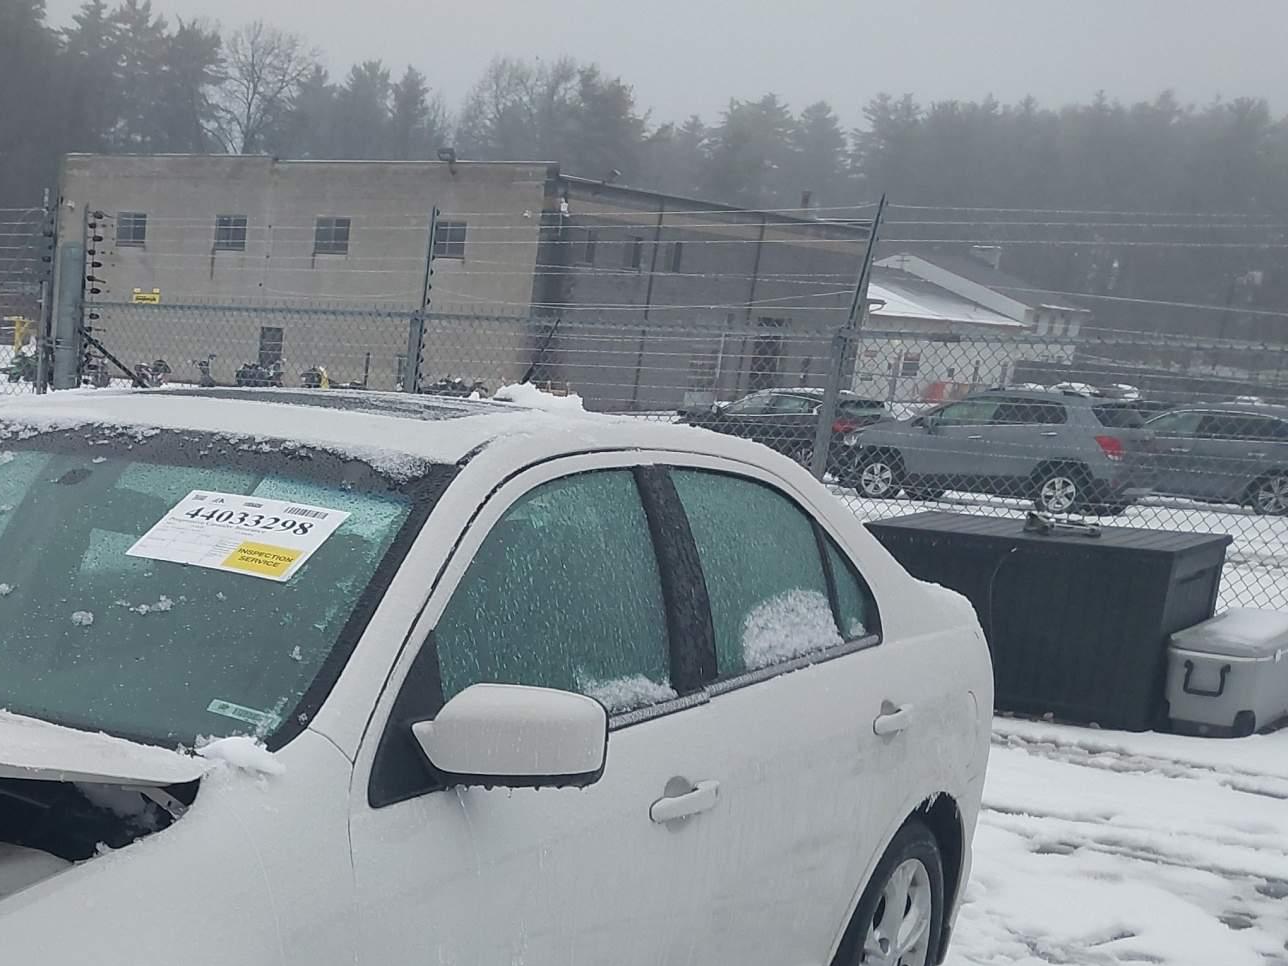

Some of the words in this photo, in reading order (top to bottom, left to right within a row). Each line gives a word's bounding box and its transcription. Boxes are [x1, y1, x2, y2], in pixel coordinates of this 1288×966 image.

[184, 506, 314, 536] 44033298
[238, 547, 294, 563] INSPECTION
[238, 555, 281, 568] SERVICE
